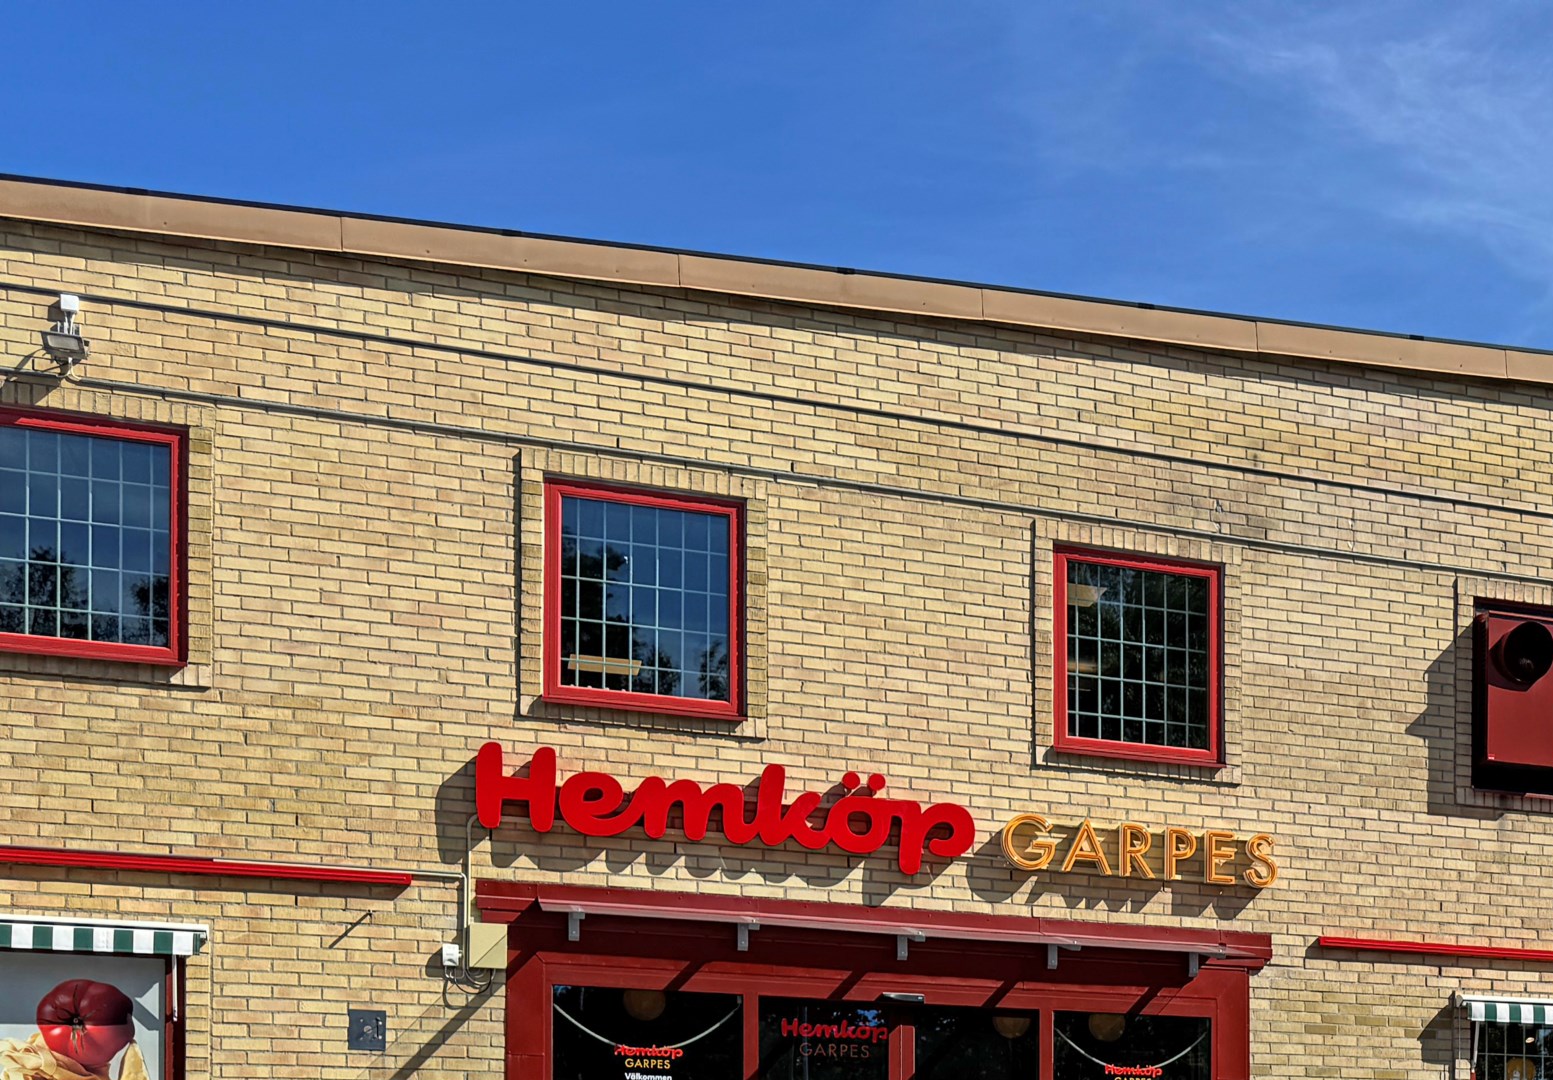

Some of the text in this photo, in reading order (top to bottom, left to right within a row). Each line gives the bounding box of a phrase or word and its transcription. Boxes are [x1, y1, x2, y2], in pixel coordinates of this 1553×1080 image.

[475, 741, 1278, 889] Hemköp GARPES
[799, 1042, 870, 1058] GARPES
[625, 1058, 671, 1069] GARPES
